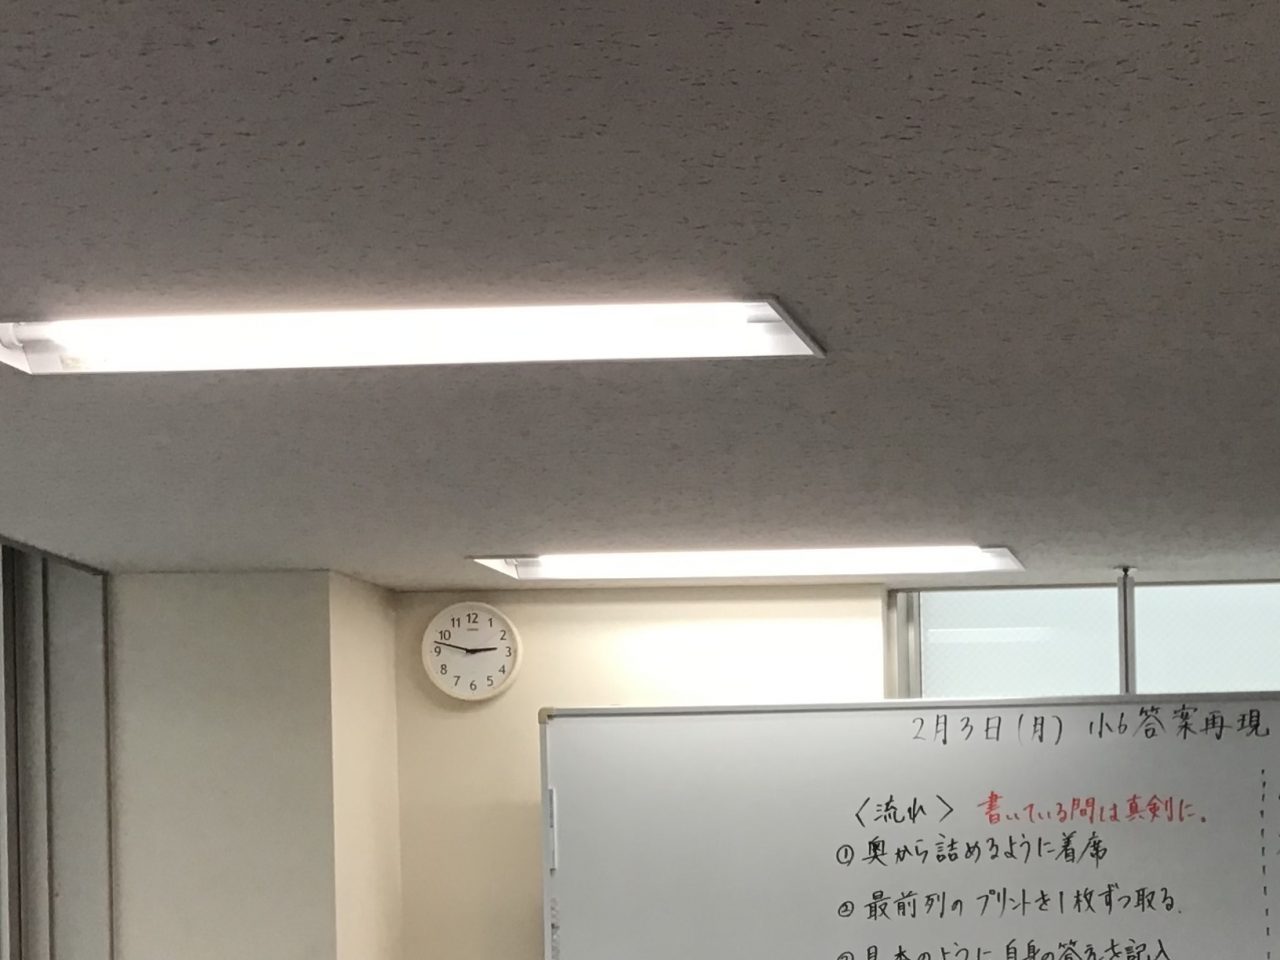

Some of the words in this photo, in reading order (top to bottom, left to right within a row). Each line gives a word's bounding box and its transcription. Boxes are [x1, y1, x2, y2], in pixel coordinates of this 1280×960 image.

[450, 617, 461, 628] 11
[466, 612, 479, 624] 12
[488, 617, 493, 628] 1
[438, 629, 451, 641] 10
[500, 629, 507, 641] 2
[433, 646, 441, 657] 9
[505, 646, 512, 657] 3
[440, 663, 448, 675] 8
[498, 664, 506, 675] 4
[453, 675, 461, 687] 7
[469, 680, 477, 691] 6
[486, 675, 494, 687] 5
